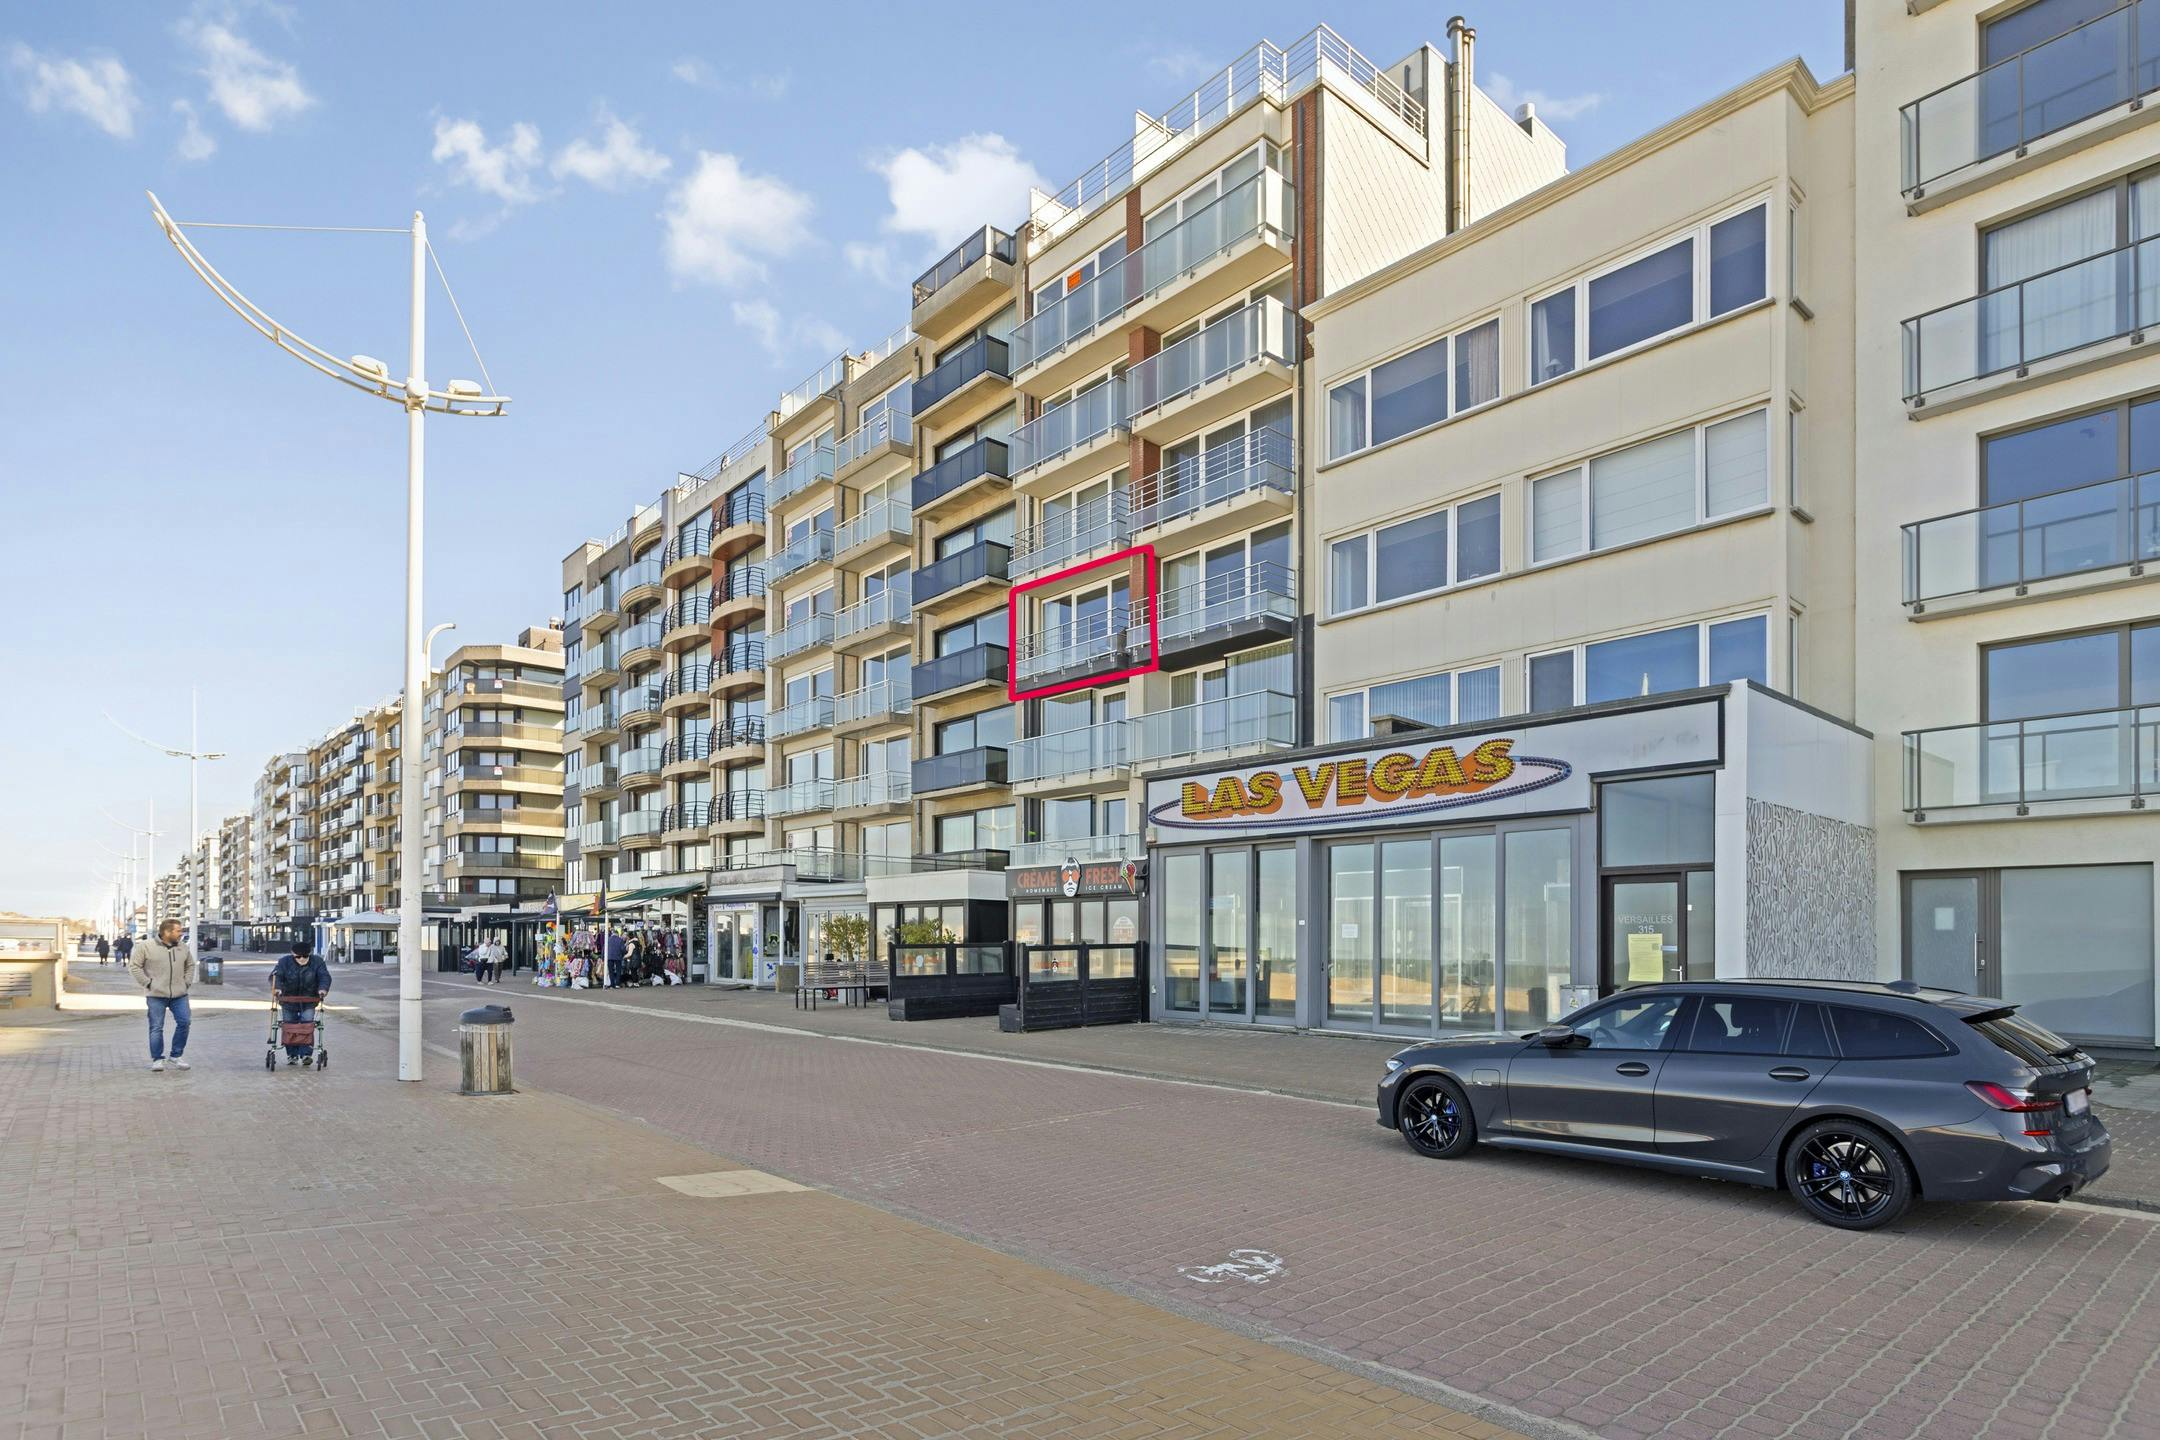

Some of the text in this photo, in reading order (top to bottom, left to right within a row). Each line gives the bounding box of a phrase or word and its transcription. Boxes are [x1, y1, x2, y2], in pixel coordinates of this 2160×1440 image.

[1180, 738, 1517, 819] LAS VEGAS
[1617, 914, 1673, 924] VERSAILLES
[1638, 925, 1655, 934] 315
